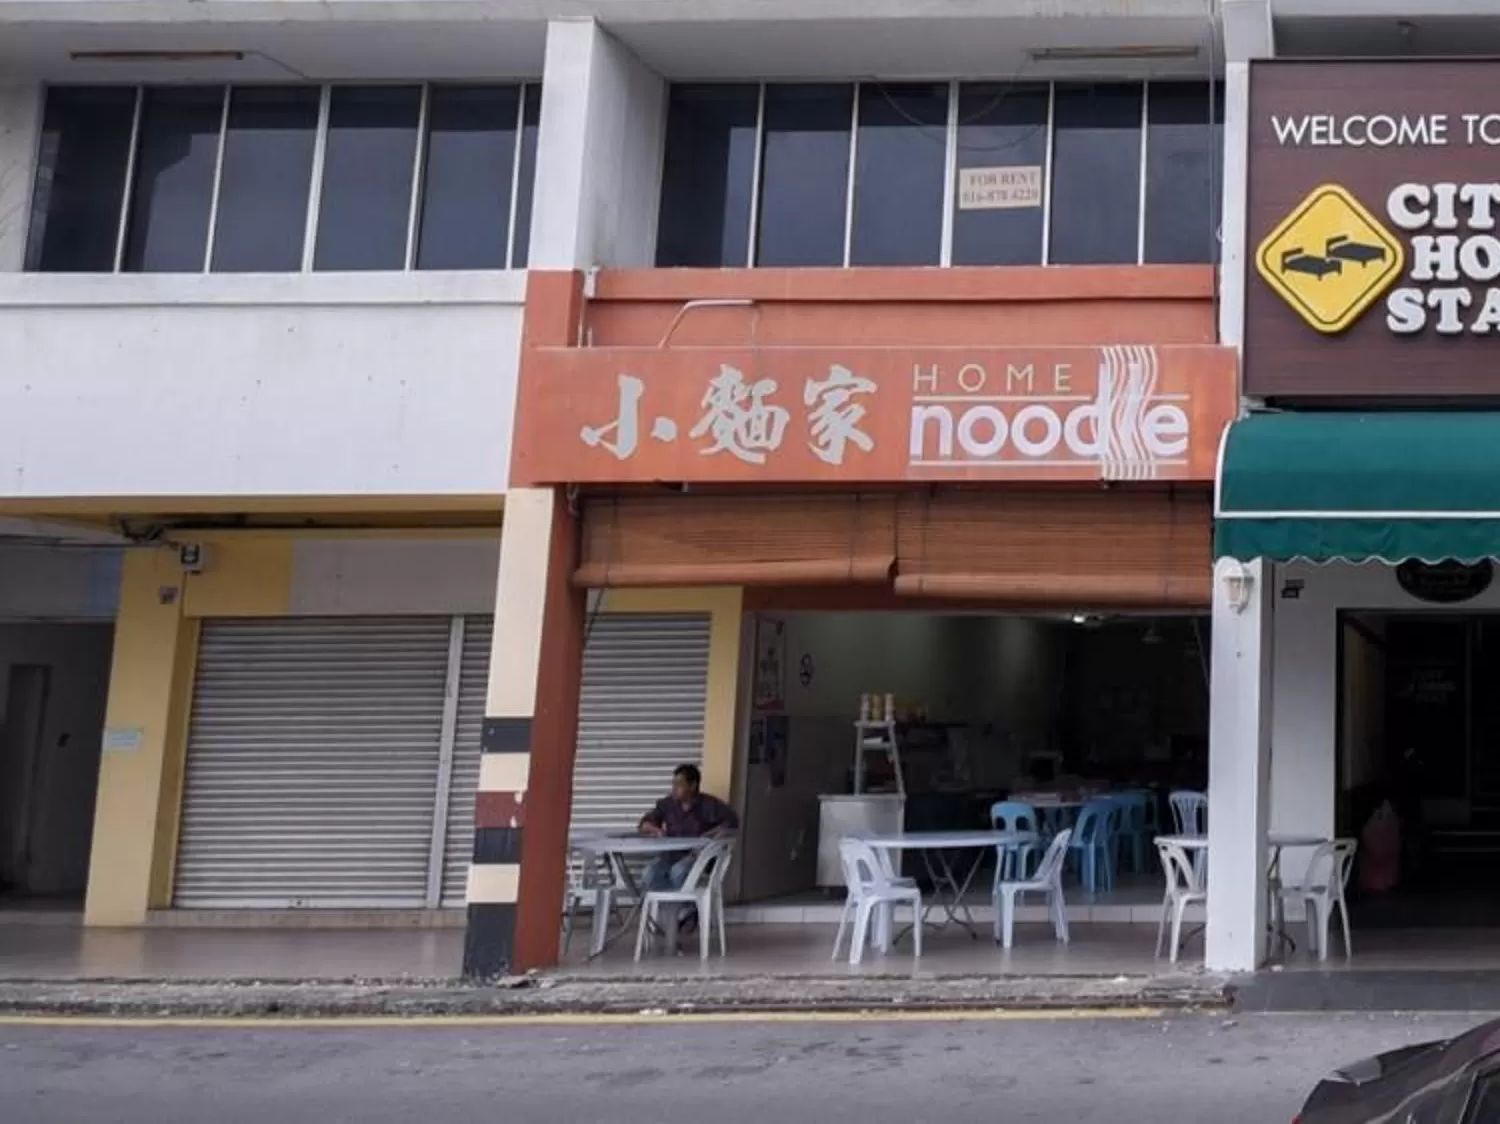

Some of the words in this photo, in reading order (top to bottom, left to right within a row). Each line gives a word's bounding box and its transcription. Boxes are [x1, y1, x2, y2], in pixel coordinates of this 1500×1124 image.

[1272, 115, 1448, 146] WELCOME
[969, 173, 997, 186] FOR
[1000, 171, 1037, 186] RENT
[912, 363, 1073, 393] HOME
[579, 363, 878, 465] 小麵家
[909, 361, 1190, 457] noodle
